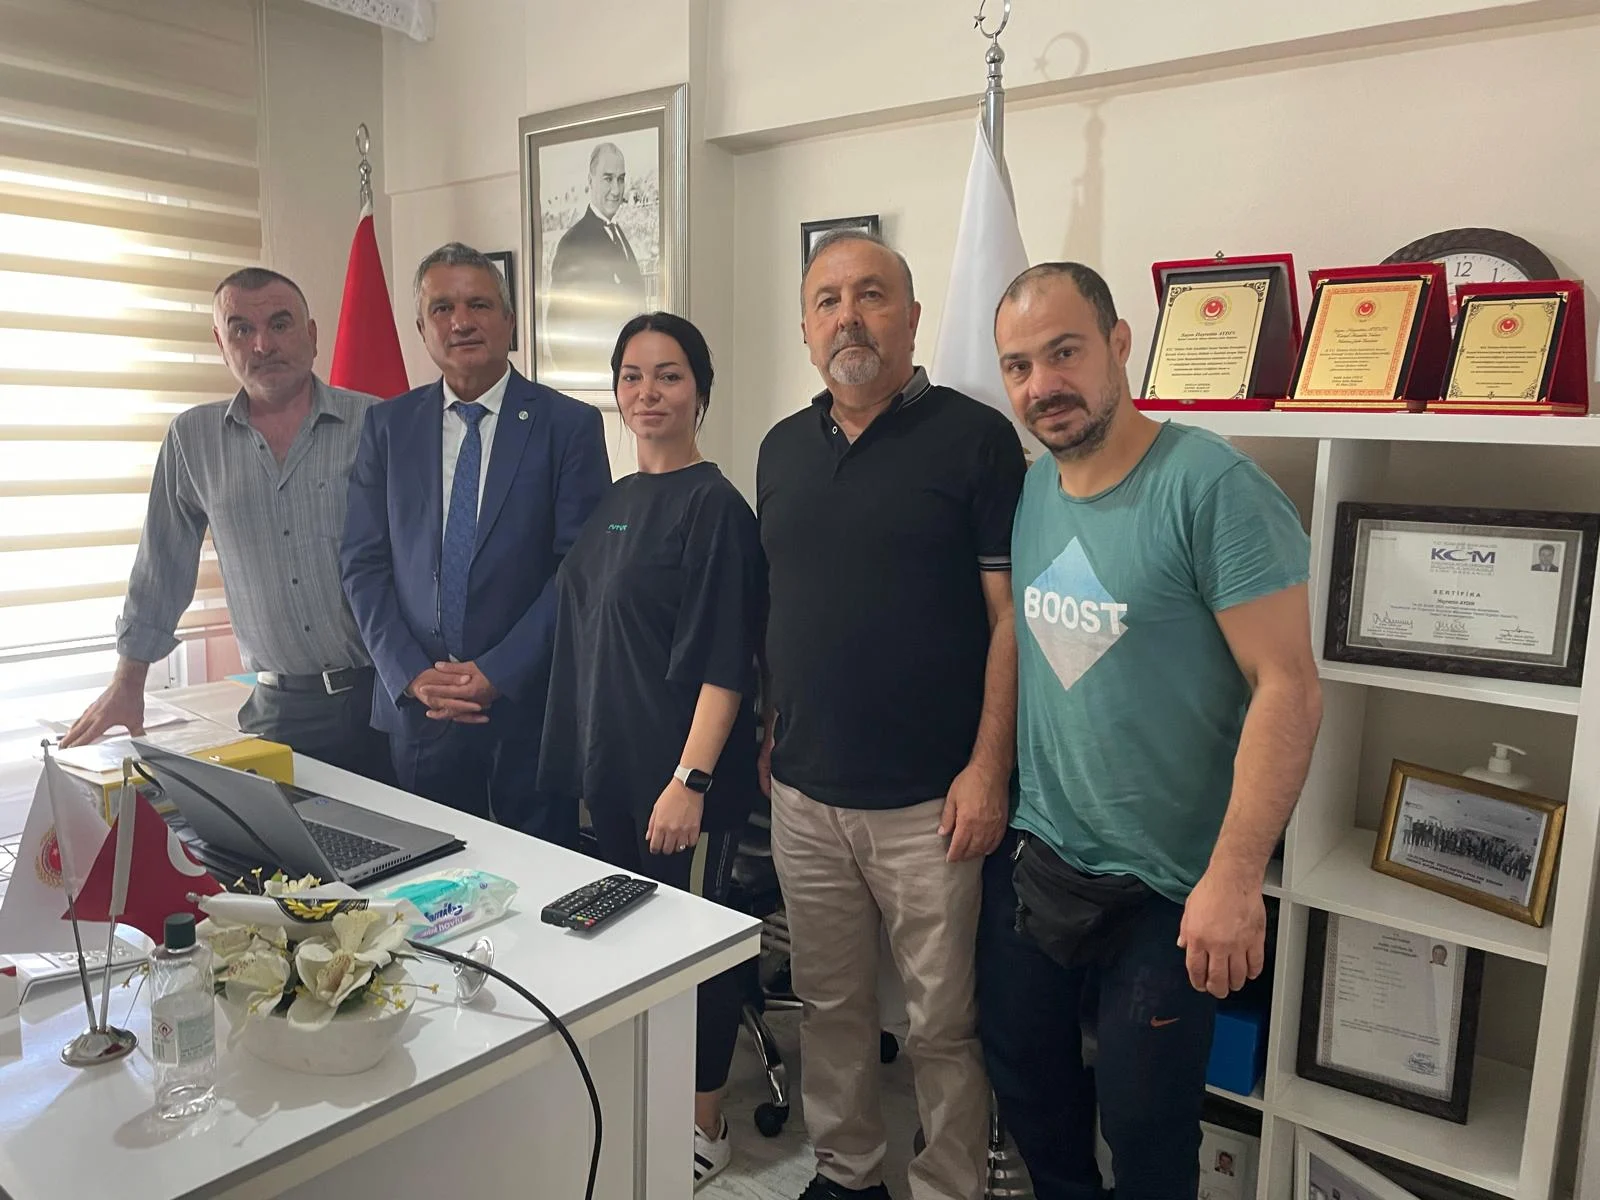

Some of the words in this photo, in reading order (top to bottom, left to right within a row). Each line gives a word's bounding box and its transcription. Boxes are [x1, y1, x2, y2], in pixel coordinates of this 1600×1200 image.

[1454, 261, 1473, 278] 12
[1492, 267, 1499, 283] 1
[1024, 586, 1127, 634] BOOST
